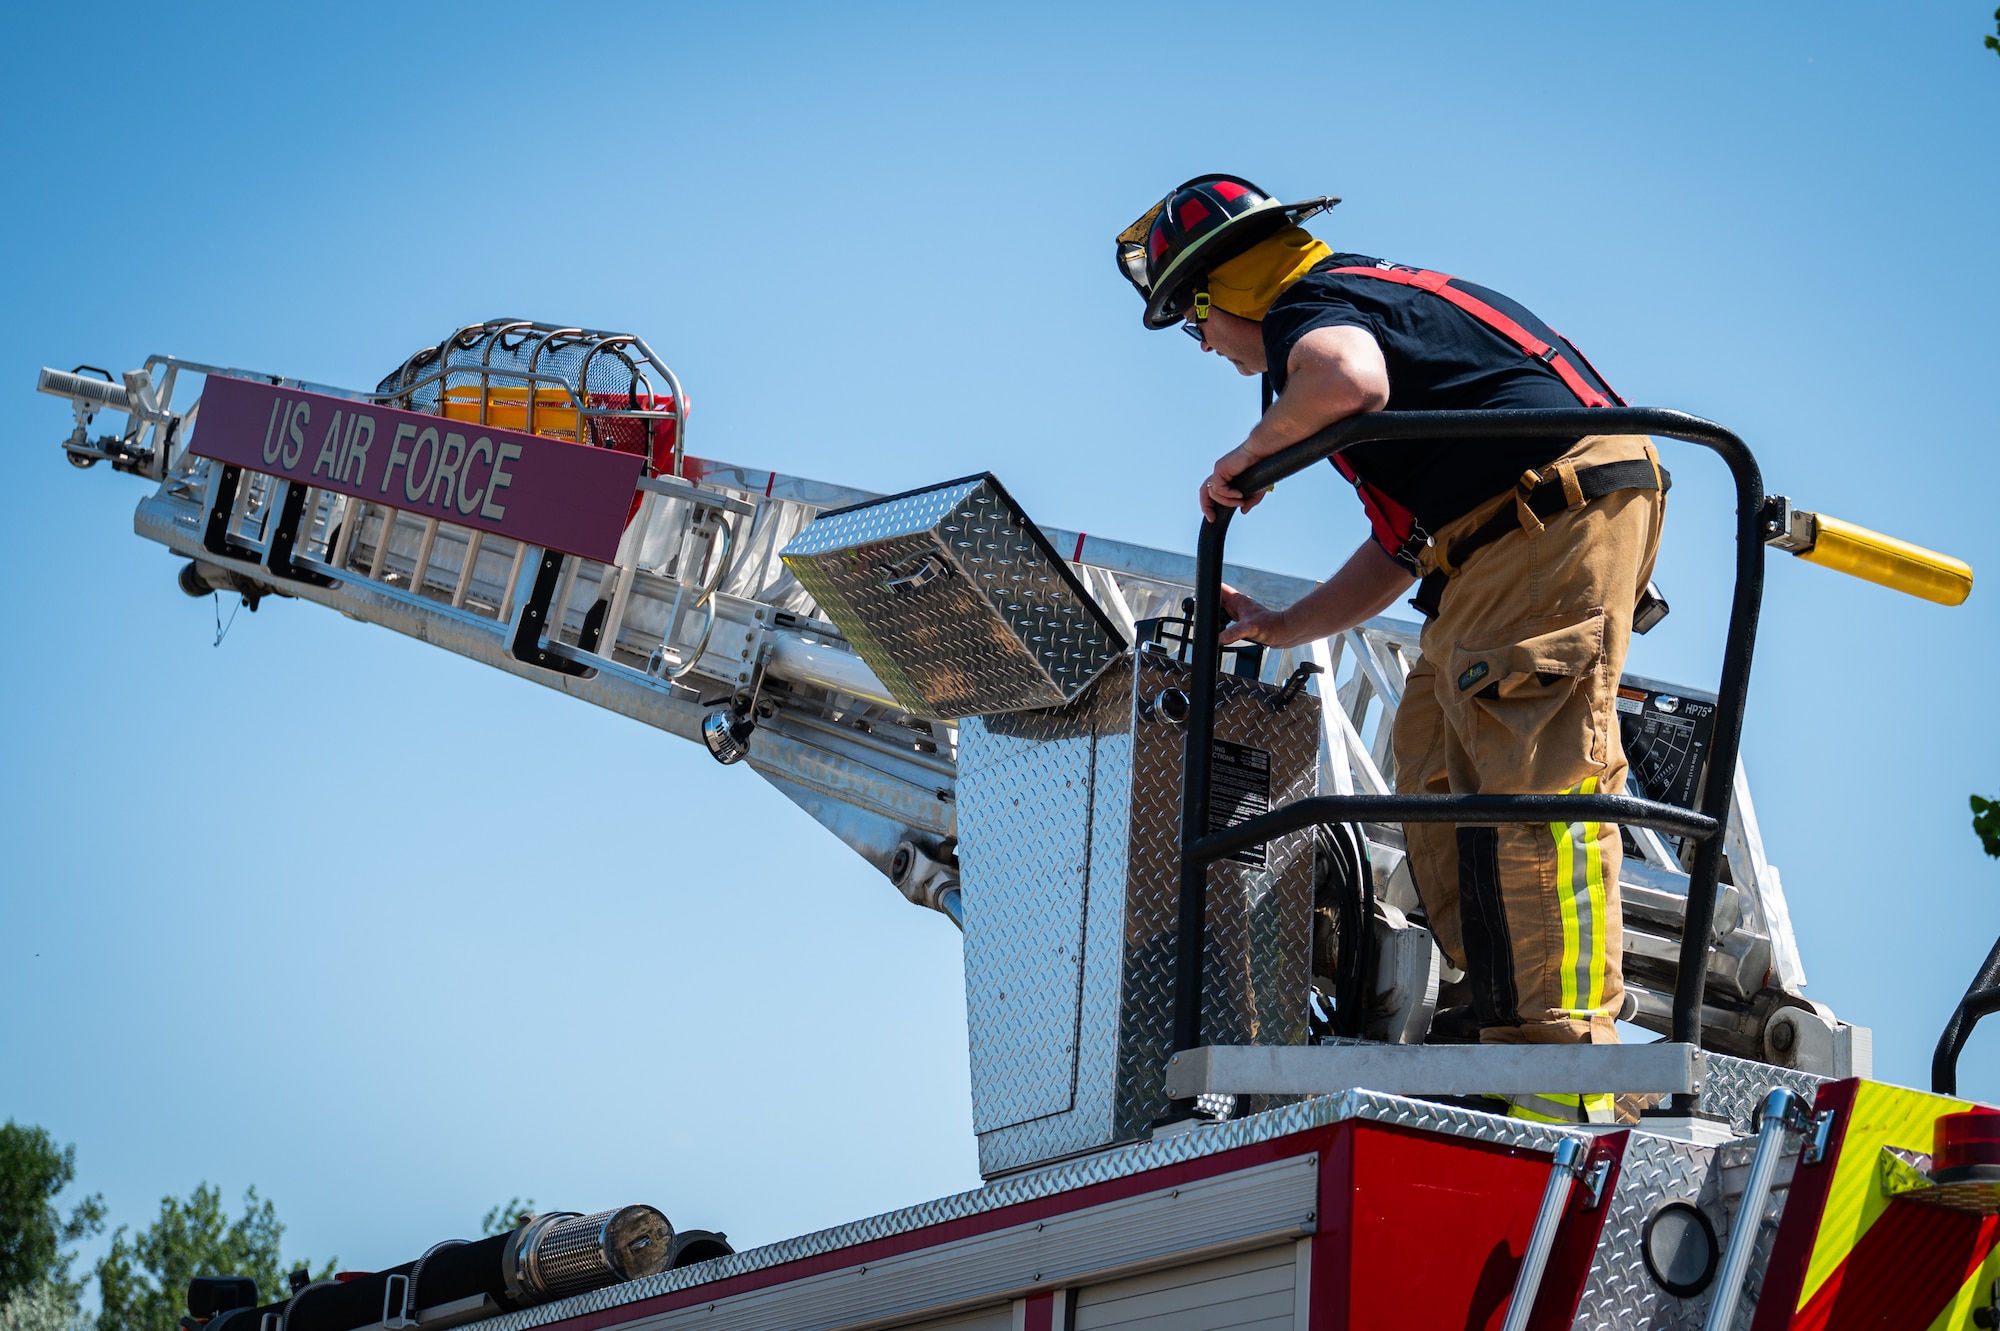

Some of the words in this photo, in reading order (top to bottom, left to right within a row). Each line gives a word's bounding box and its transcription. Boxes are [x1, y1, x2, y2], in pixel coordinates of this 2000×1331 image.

[262, 397, 311, 470] US
[311, 410, 376, 487] AIR
[380, 423, 523, 521] FORCE
